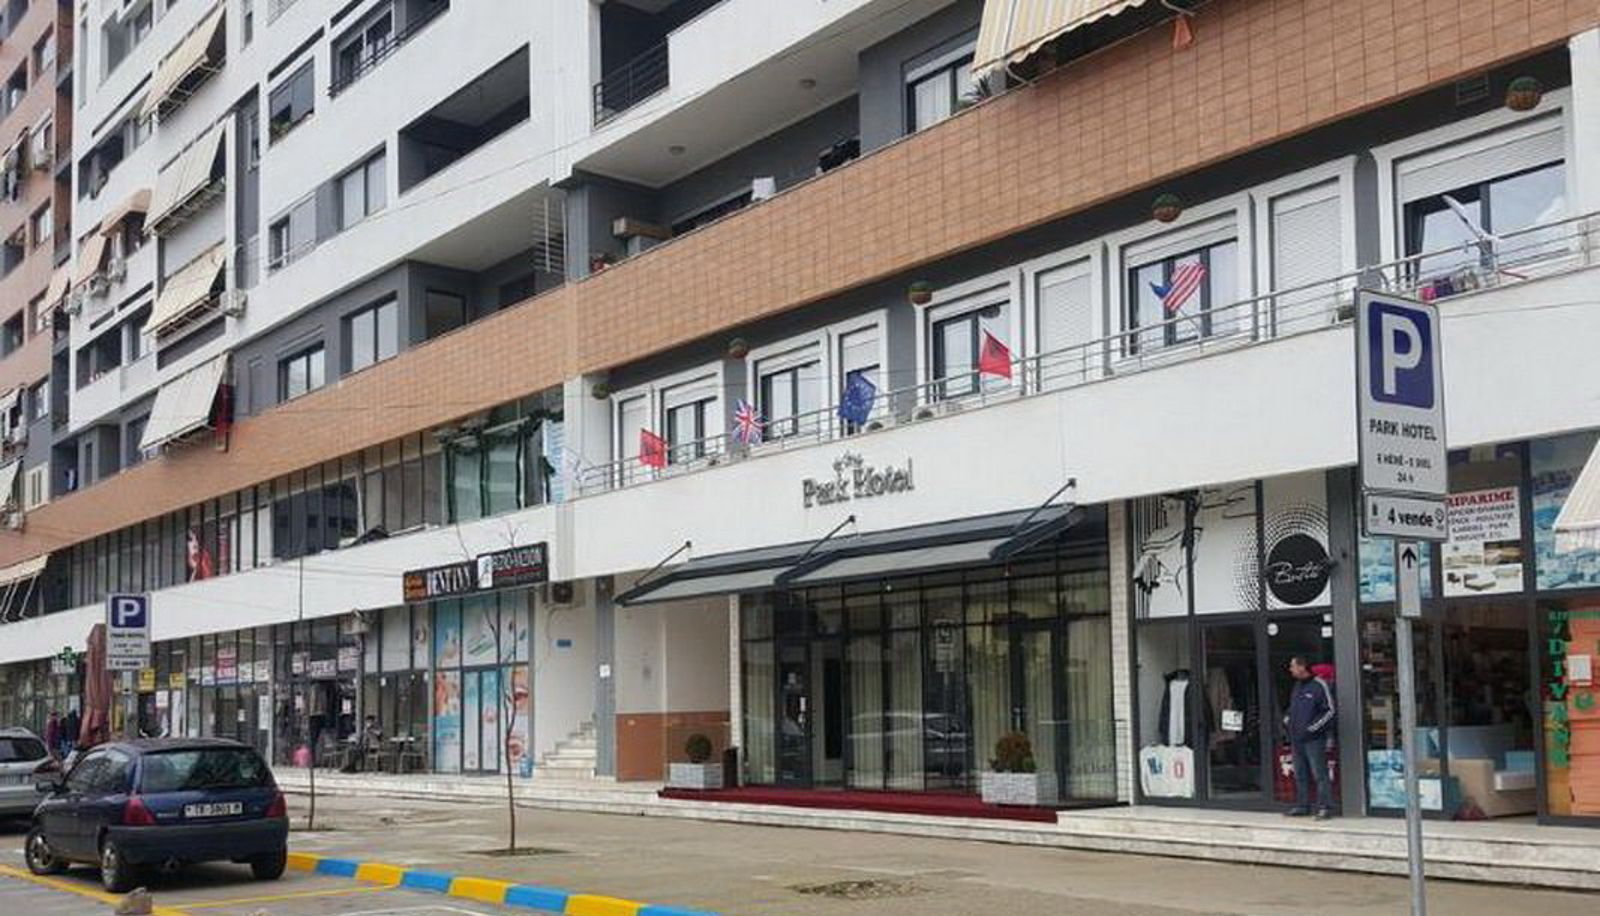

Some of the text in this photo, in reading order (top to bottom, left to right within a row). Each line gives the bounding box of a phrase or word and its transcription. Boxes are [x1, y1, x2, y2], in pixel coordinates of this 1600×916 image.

[1381, 312, 1423, 395] P
[1369, 418, 1437, 441] PARK HOTEL
[803, 458, 914, 508] Park Hotel
[1387, 507, 1396, 525] 4
[1398, 511, 1434, 527] vende
[118, 599, 141, 626] P
